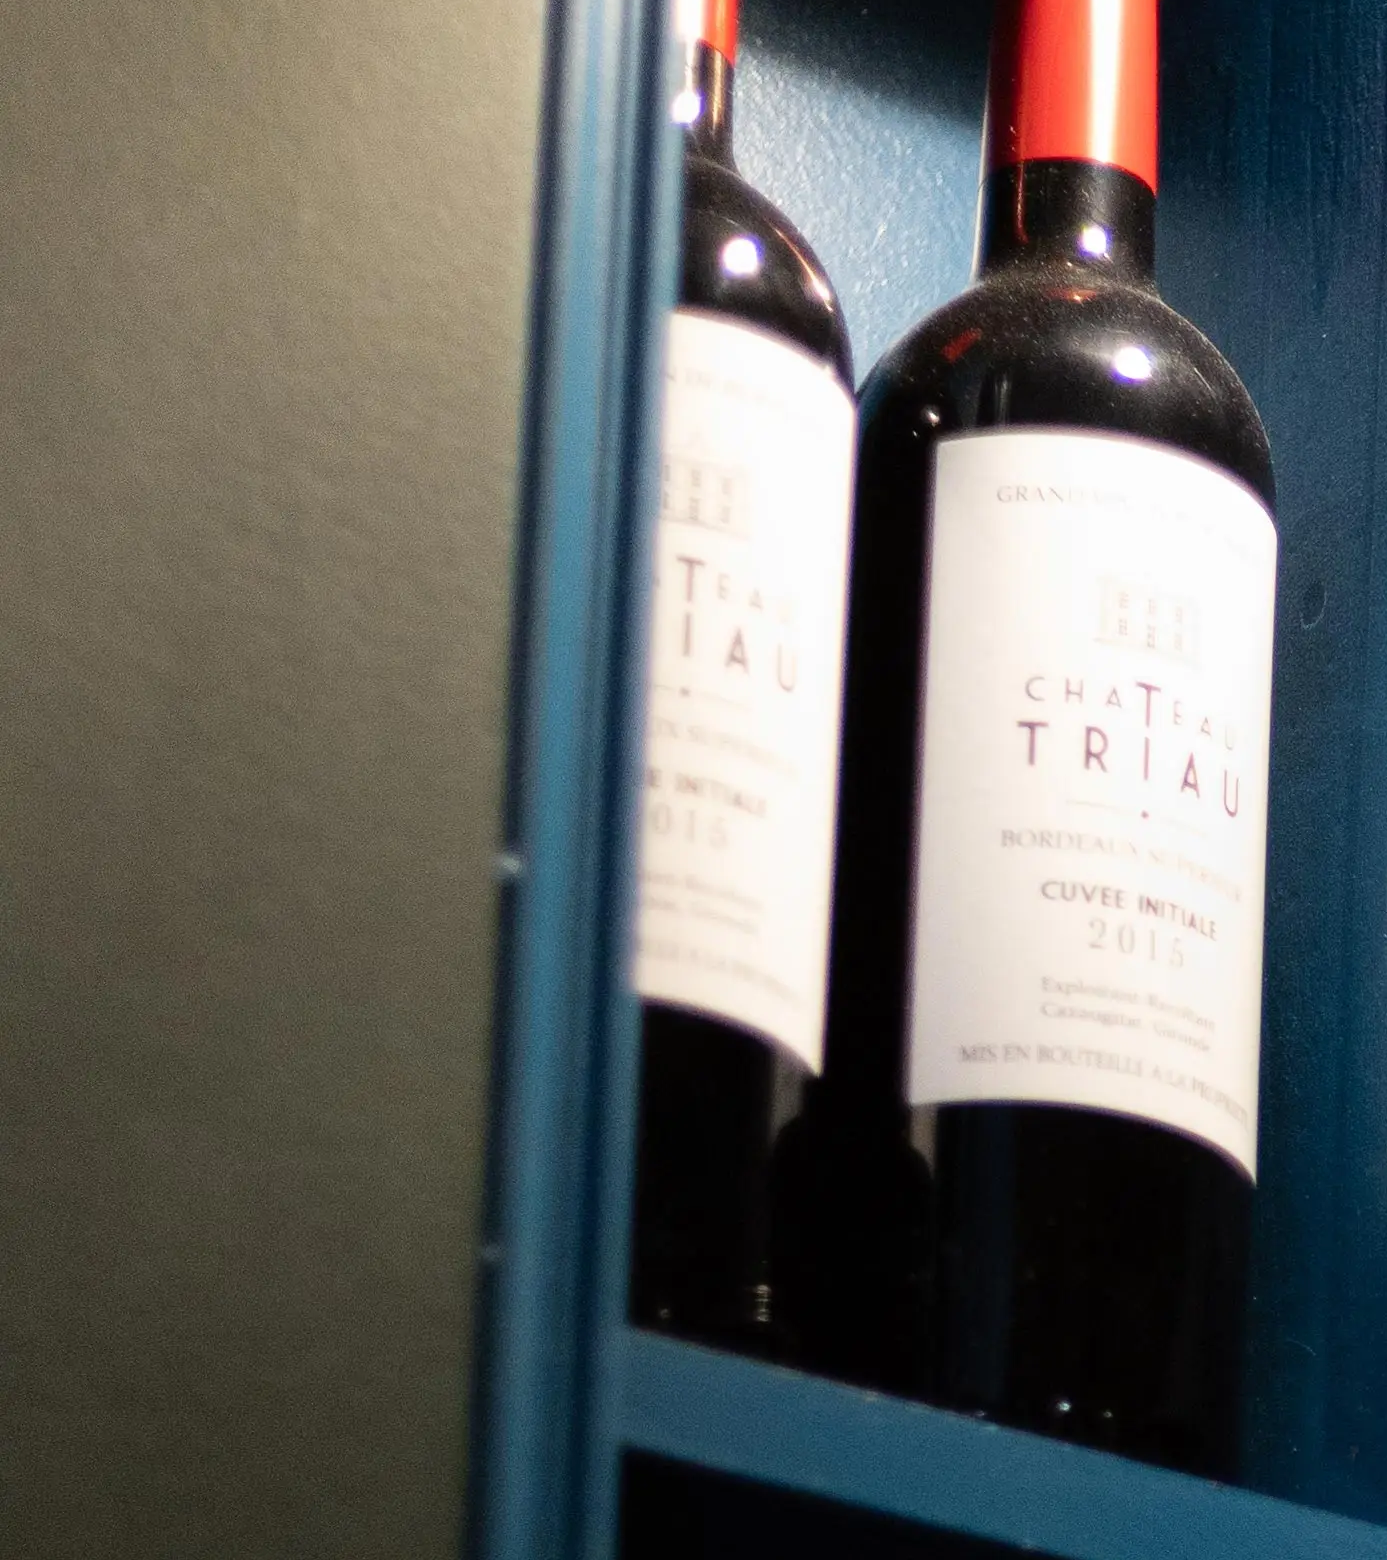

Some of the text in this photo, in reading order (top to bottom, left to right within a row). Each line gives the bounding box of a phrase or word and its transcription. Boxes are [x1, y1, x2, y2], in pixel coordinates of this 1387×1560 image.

[1025, 676, 1234, 751] CHATEAU
[1016, 721, 1239, 817] TRIAU
[650, 802, 730, 850] 015
[1040, 879, 1217, 941] CUVEE INITIALE
[1087, 918, 1184, 969] 2015
[1003, 1044, 1031, 1063] EN
